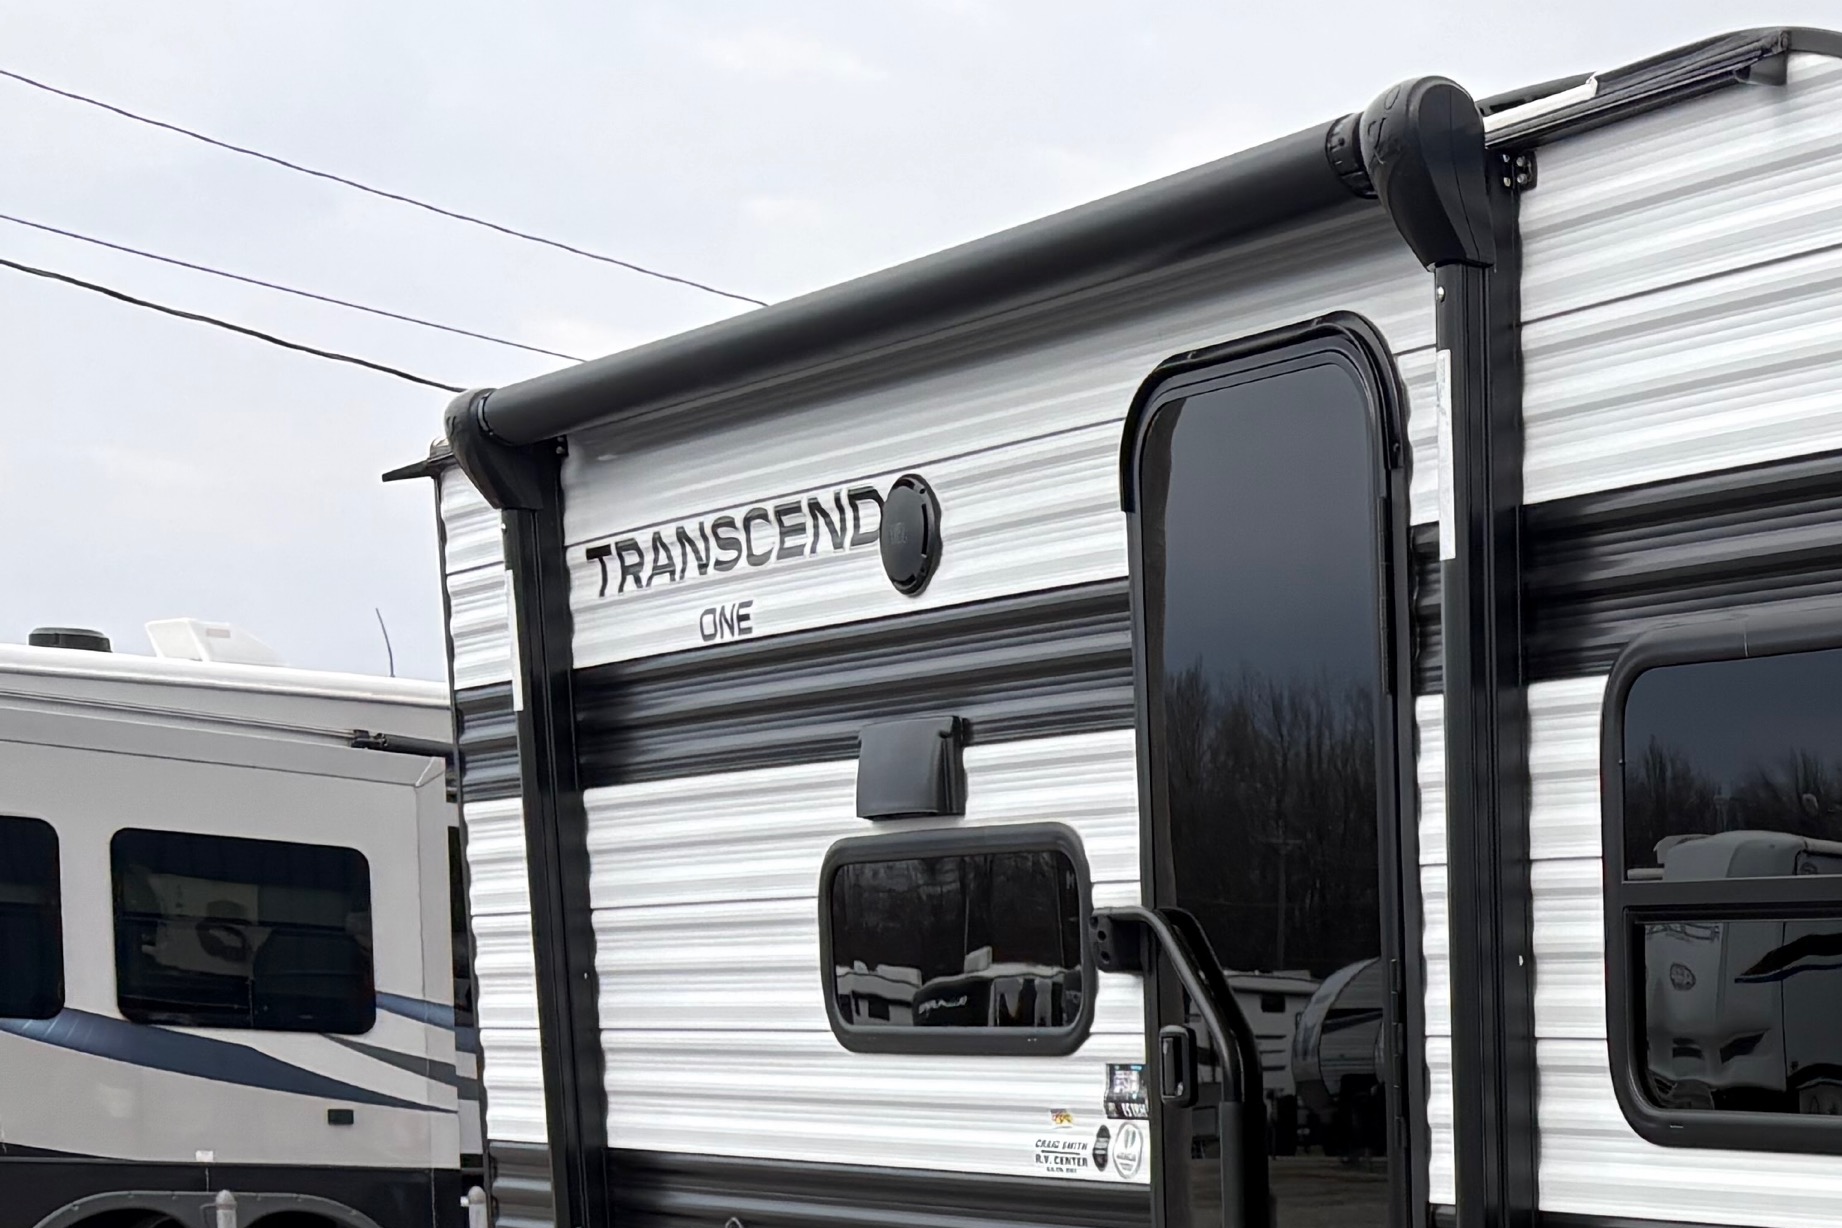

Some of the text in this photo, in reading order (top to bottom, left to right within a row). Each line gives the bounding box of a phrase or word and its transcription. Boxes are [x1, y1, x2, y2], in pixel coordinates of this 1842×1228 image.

[586, 486, 885, 597] TRANSCEND
[699, 600, 753, 642] ONE
[1054, 1155, 1088, 1167] CENTER
